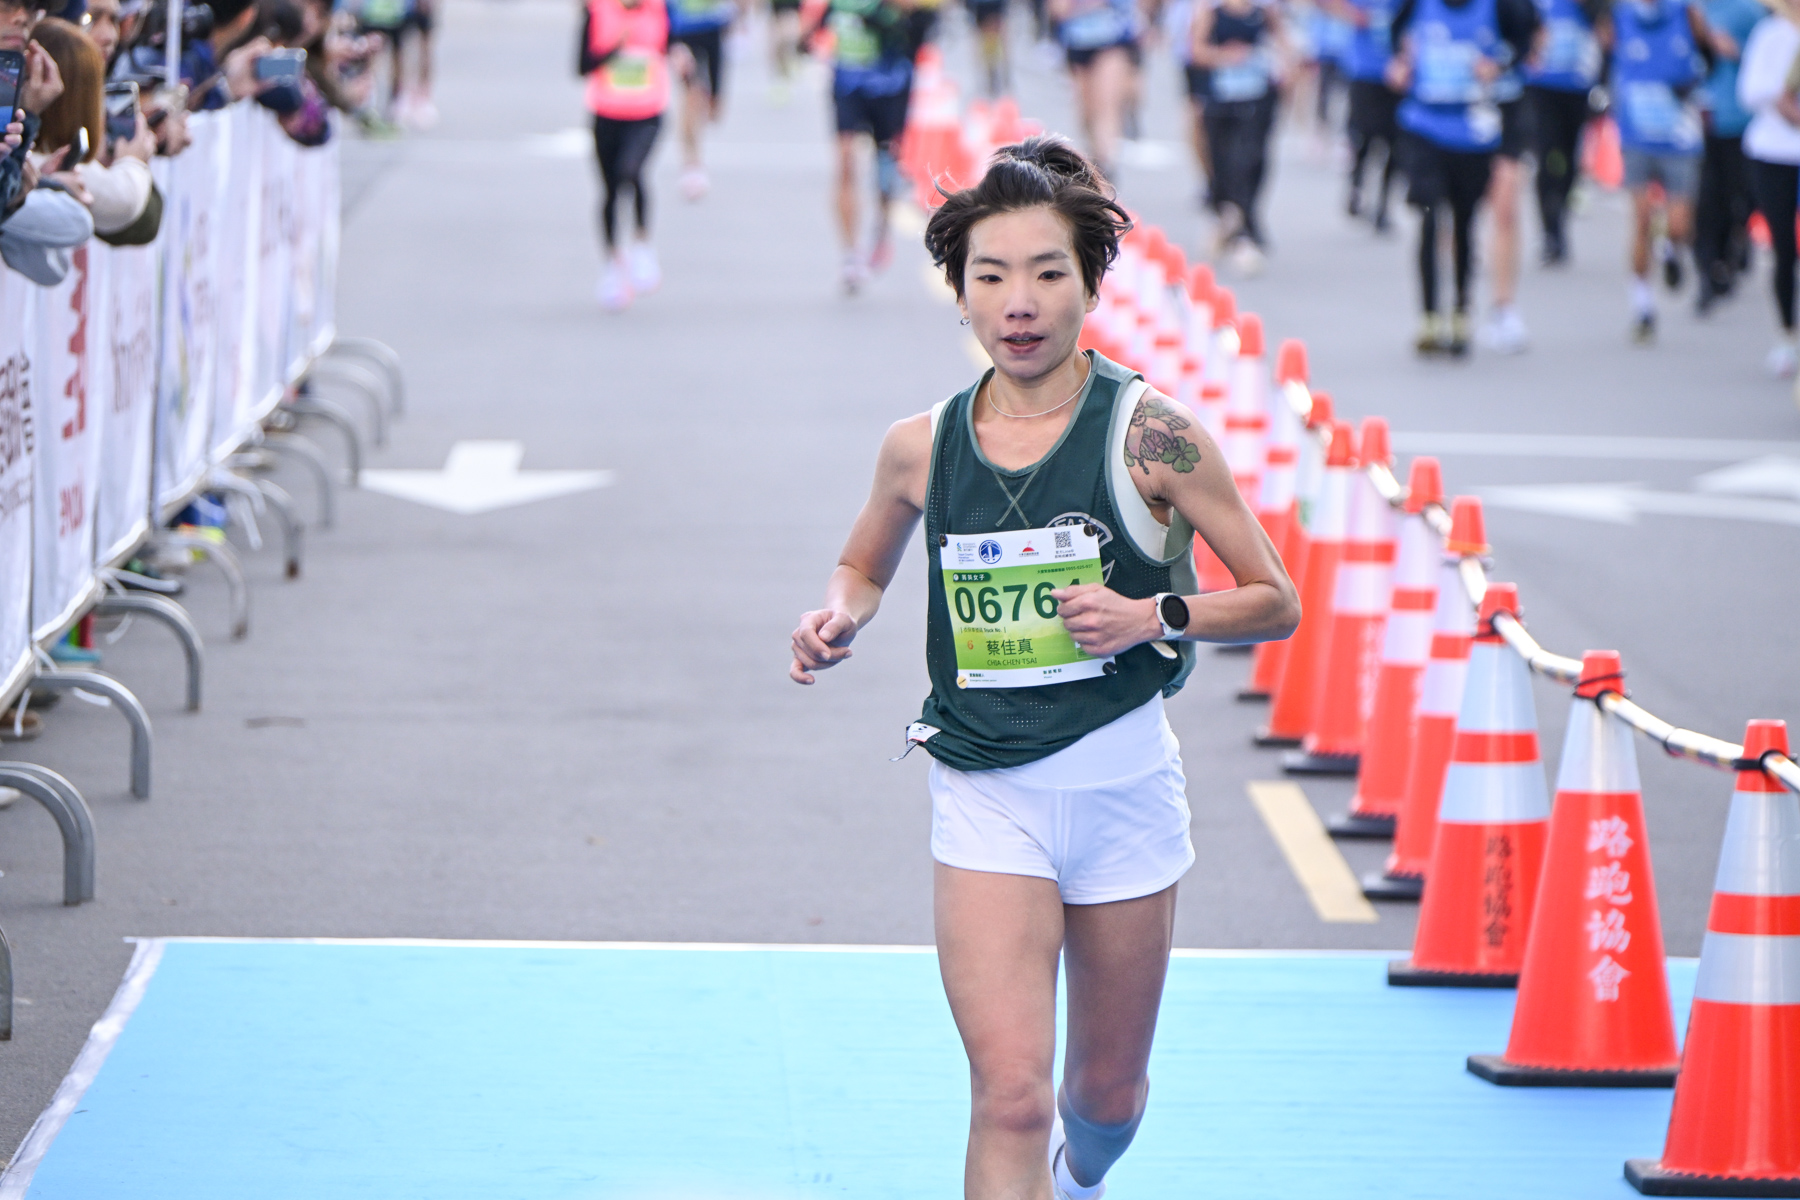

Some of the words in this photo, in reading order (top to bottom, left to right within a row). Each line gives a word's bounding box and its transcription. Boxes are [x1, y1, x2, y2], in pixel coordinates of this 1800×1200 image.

[954, 578, 1080, 624] 0676
[967, 640, 974, 650] 6
[986, 638, 1034, 656] 蔡佳真
[987, 659, 1001, 667] CHIA
[1002, 658, 1021, 666] CHEN
[1022, 657, 1038, 665] TSAI
[1585, 814, 1634, 1003] 路跑協會
